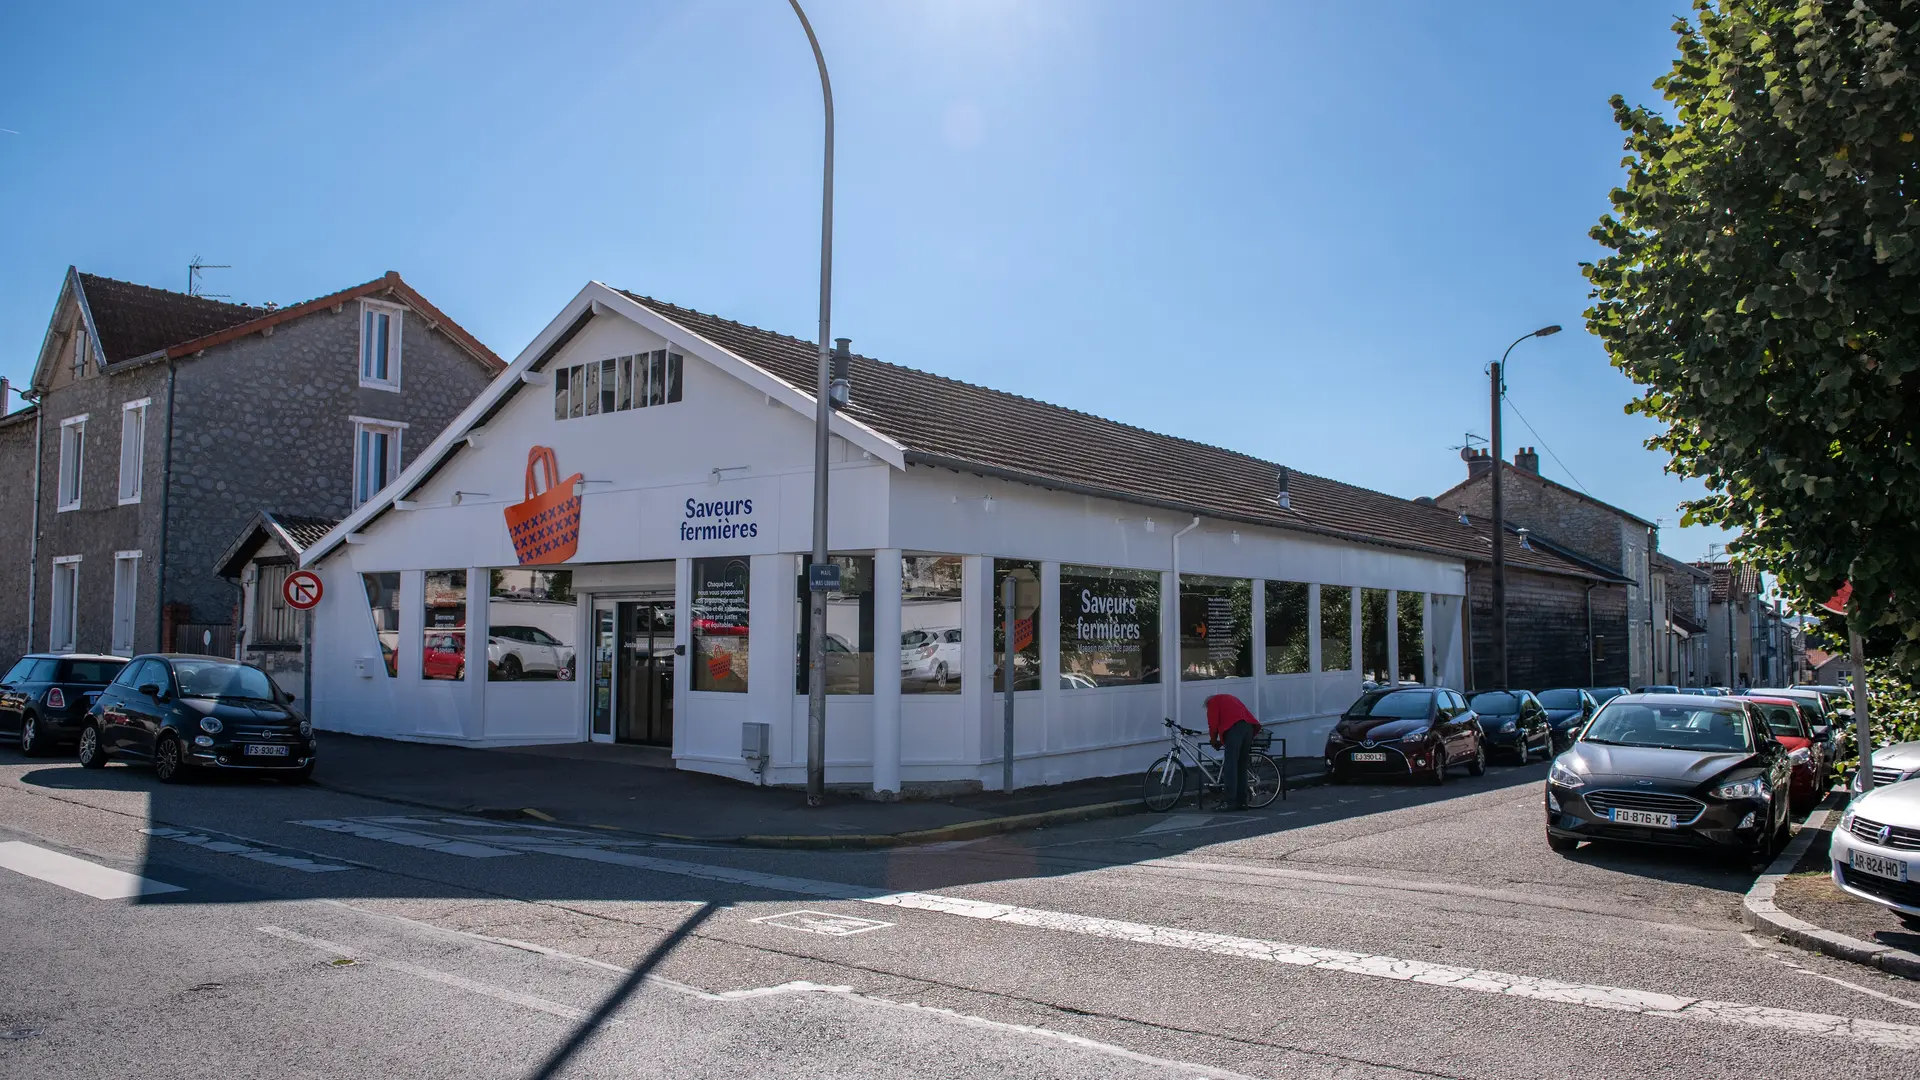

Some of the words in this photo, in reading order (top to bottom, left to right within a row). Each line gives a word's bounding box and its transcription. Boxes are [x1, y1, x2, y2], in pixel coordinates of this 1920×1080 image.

[685, 498, 753, 518] Saveurs
[680, 518, 758, 541] fermières
[1081, 589, 1137, 614] Saveurs
[1077, 615, 1140, 640] fermières
